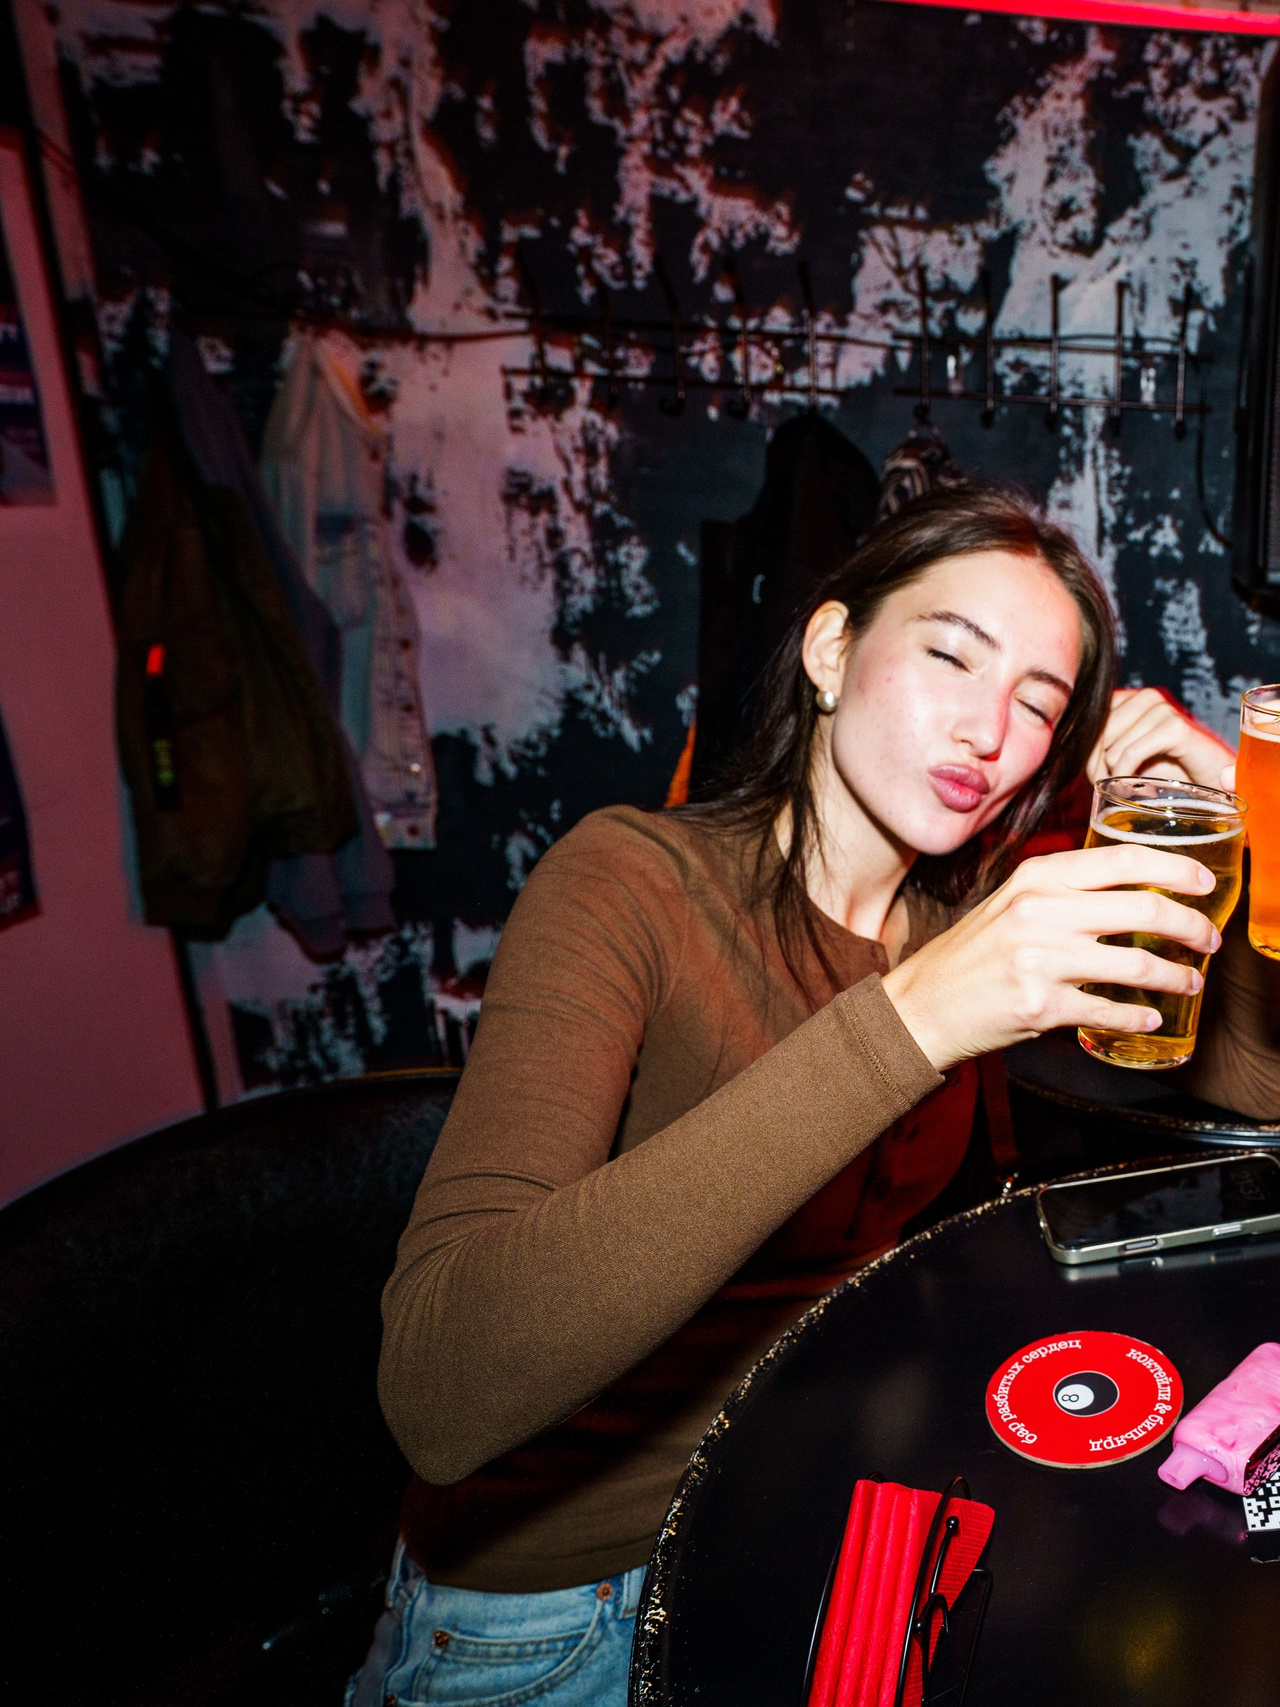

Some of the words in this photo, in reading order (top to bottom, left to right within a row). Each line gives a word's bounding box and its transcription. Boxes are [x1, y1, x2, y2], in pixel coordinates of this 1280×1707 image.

[1022, 1339, 1082, 1364] сердец
[1126, 1348, 1173, 1402] коктейли
[992, 1362, 1025, 1423] разбитых
[1061, 1393, 1079, 1403] 8
[1154, 1402, 1172, 1415] &
[1008, 1420, 1038, 1444] бар
[1089, 1414, 1164, 1452] бильярд
